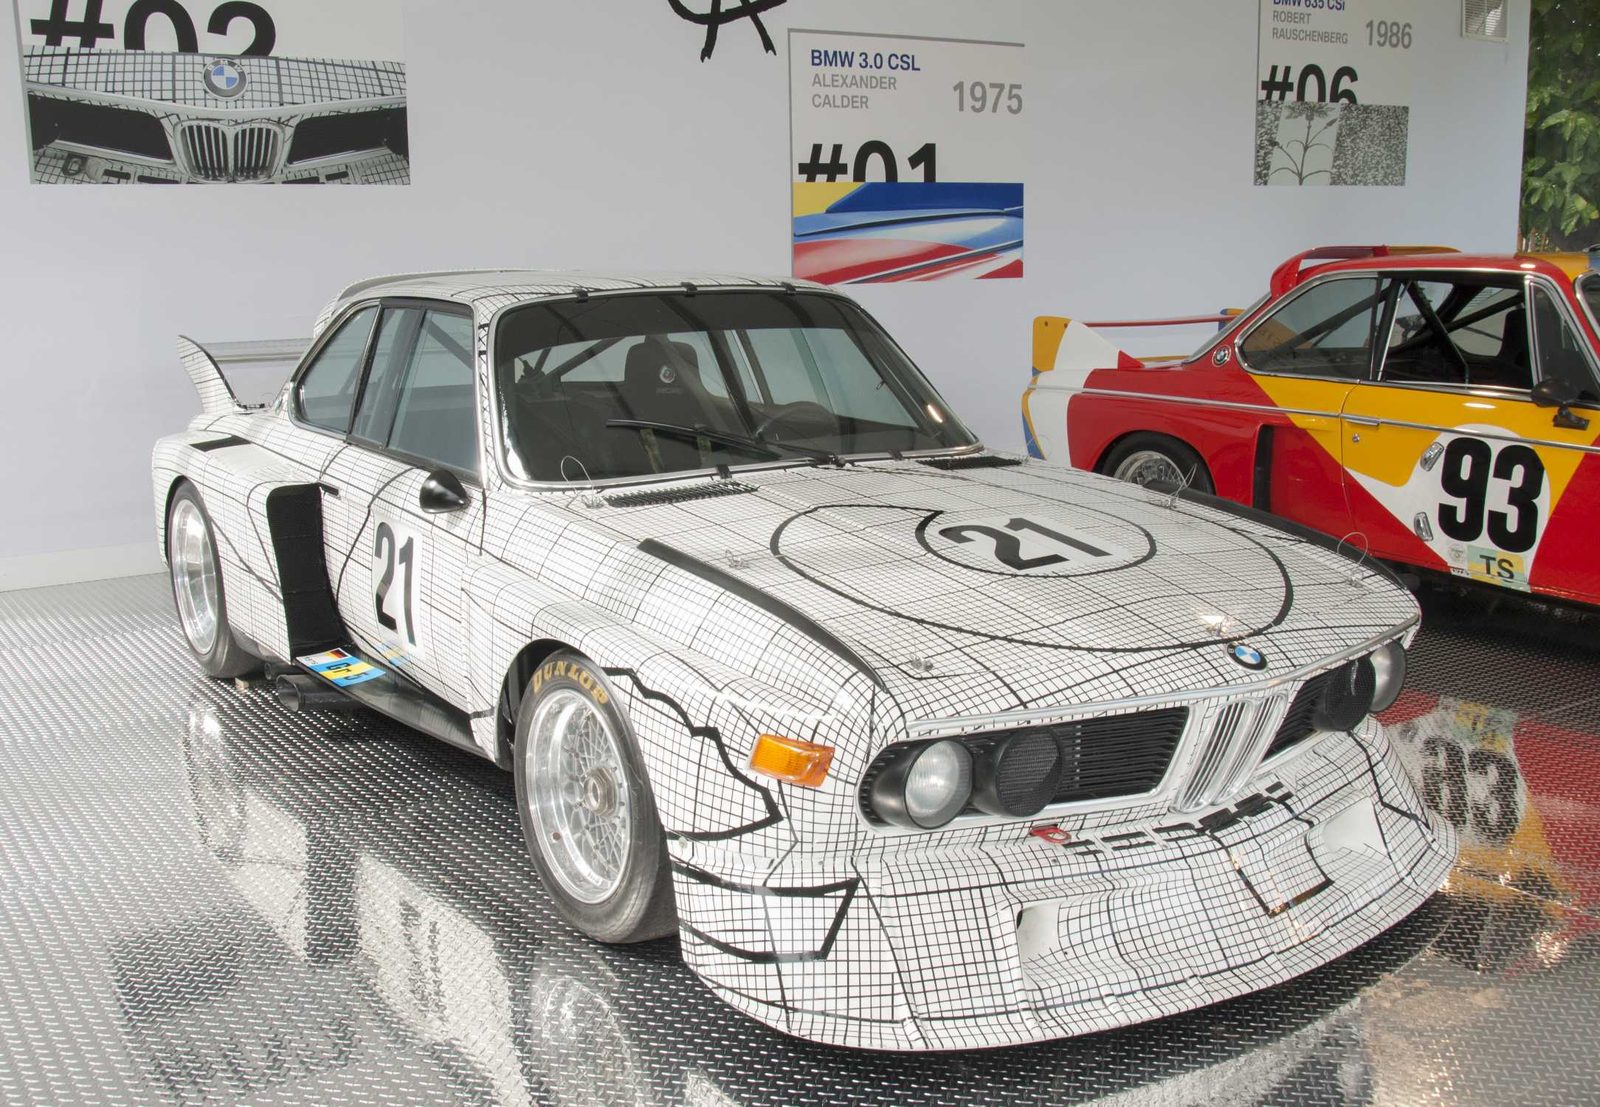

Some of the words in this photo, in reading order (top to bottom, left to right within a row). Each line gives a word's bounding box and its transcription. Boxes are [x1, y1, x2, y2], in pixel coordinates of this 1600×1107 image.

[1272, 10, 1312, 24] ROBERT
[1272, 27, 1349, 45] RAUSCHENBERG
[1366, 19, 1413, 50] 1986
[811, 49, 855, 68] BMW
[859, 52, 883, 69] 3.0
[888, 53, 920, 71] CSL
[812, 73, 897, 90] ALEXANDER
[953, 80, 1023, 115] 1975
[1261, 63, 1358, 105] #06
[811, 94, 869, 109] CALDER
[798, 140, 937, 183] #01
[1438, 437, 1545, 553] 93
[938, 517, 1113, 571] 21
[374, 521, 417, 647] 21
[1479, 554, 1514, 581] TS
[532, 660, 609, 704] DUNLOP
